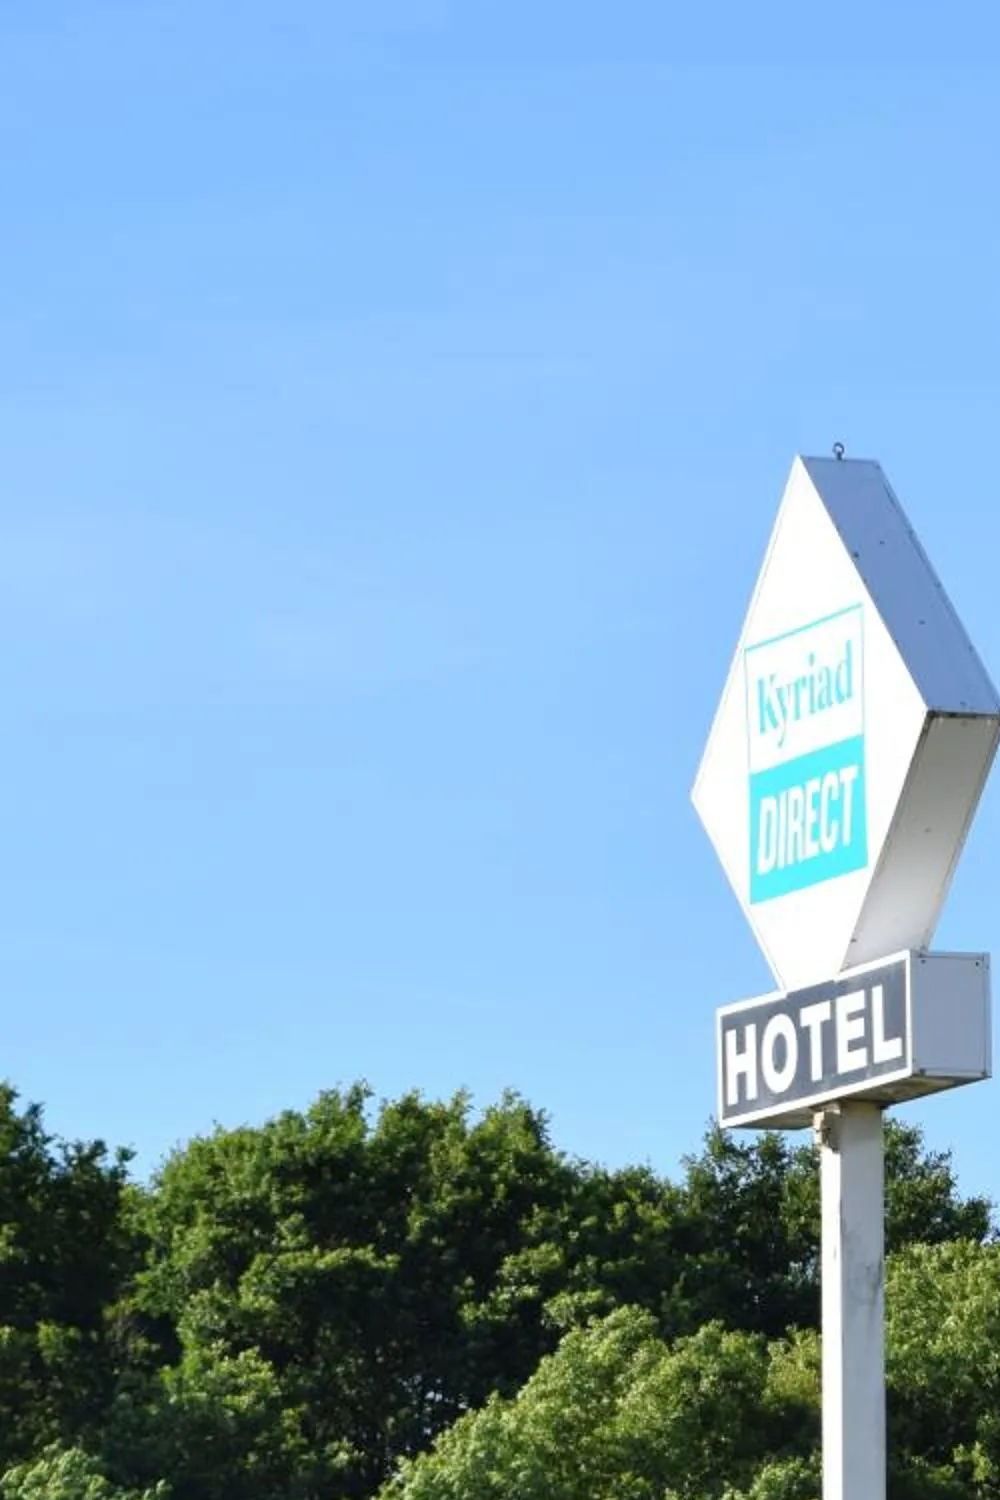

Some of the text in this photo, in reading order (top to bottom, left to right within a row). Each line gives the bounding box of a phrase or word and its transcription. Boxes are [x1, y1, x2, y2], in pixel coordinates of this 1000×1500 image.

[756, 638, 854, 749] Kyriad
[756, 765, 858, 877] DIRECT
[724, 984, 903, 1107] HOTEL
